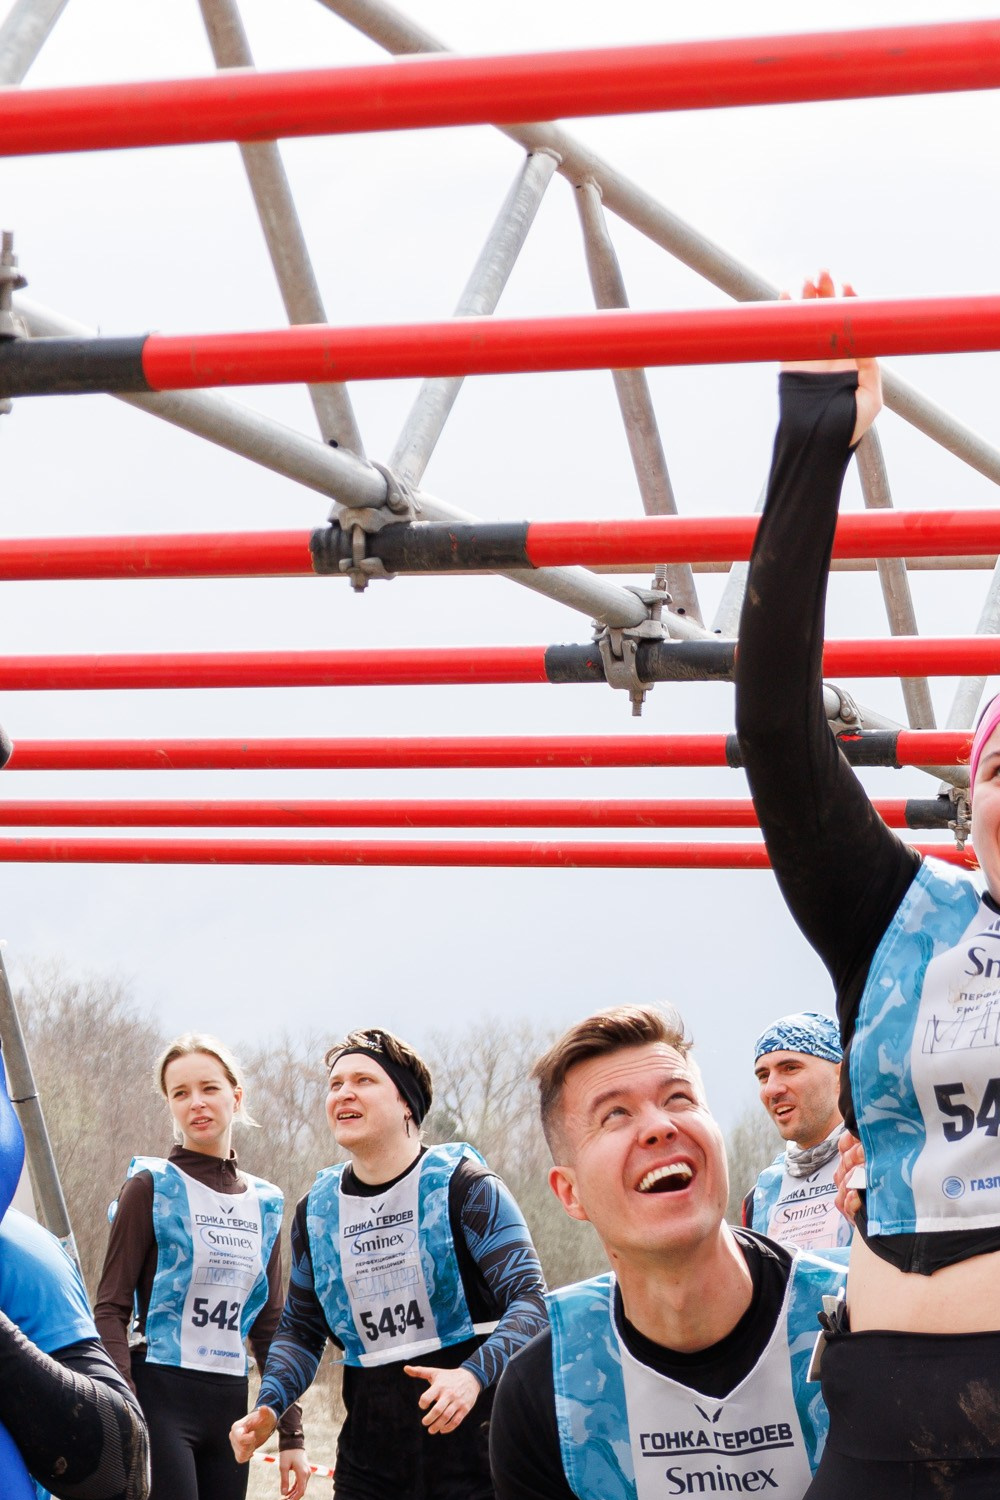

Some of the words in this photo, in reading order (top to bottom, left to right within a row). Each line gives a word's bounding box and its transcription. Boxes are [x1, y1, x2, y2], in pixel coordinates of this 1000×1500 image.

[809, 1183, 837, 1196] ГЕРОЕ
[195, 1214, 225, 1225] ГОНКА
[227, 1218, 258, 1231] ГЕРОЕВ
[344, 1220, 374, 1235] ГОНКА
[376, 1210, 414, 1226] ГЕРОЕВ
[783, 1202, 830, 1224] Sminex
[208, 1231, 253, 1250] Sminex
[354, 1233, 405, 1254] Sminex
[191, 1297, 241, 1331] 542
[360, 1299, 425, 1341] 5434
[640, 1430, 710, 1450] ГОНКА
[713, 1423, 793, 1449] ГЕРОЕВ
[665, 1464, 779, 1495] Sminex
